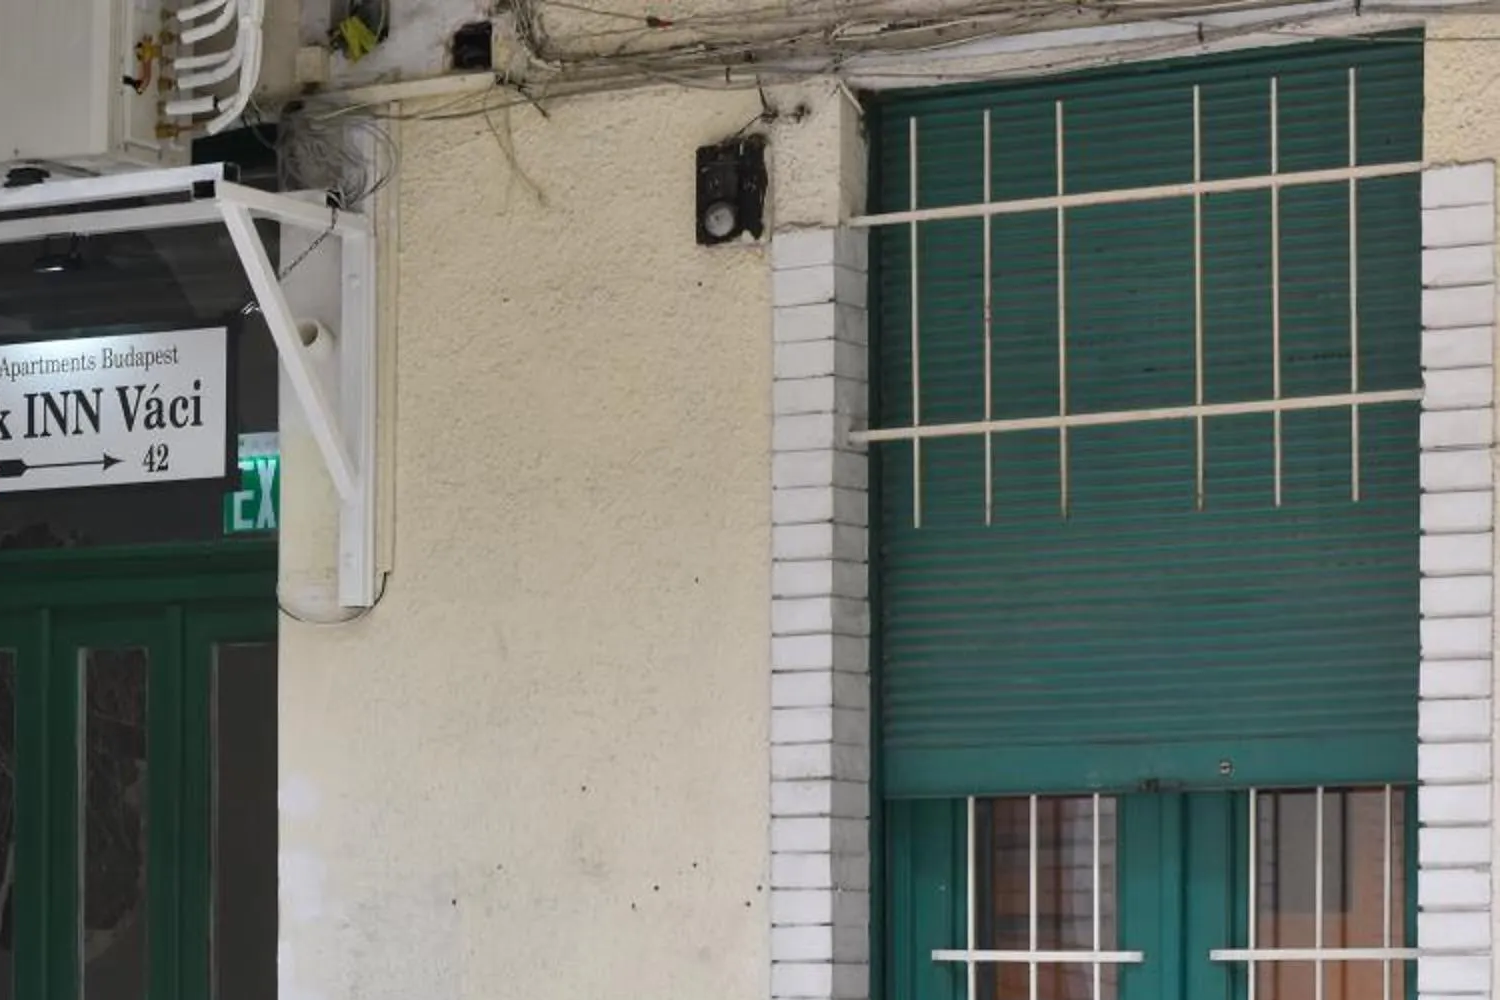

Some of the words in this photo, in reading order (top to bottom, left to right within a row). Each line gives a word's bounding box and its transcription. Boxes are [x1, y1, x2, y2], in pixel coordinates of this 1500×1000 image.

[102, 344, 179, 373] Budapest
[23, 387, 104, 440] INN
[115, 379, 204, 433] Váci
[141, 443, 170, 474] 42
[233, 457, 278, 530] EX
